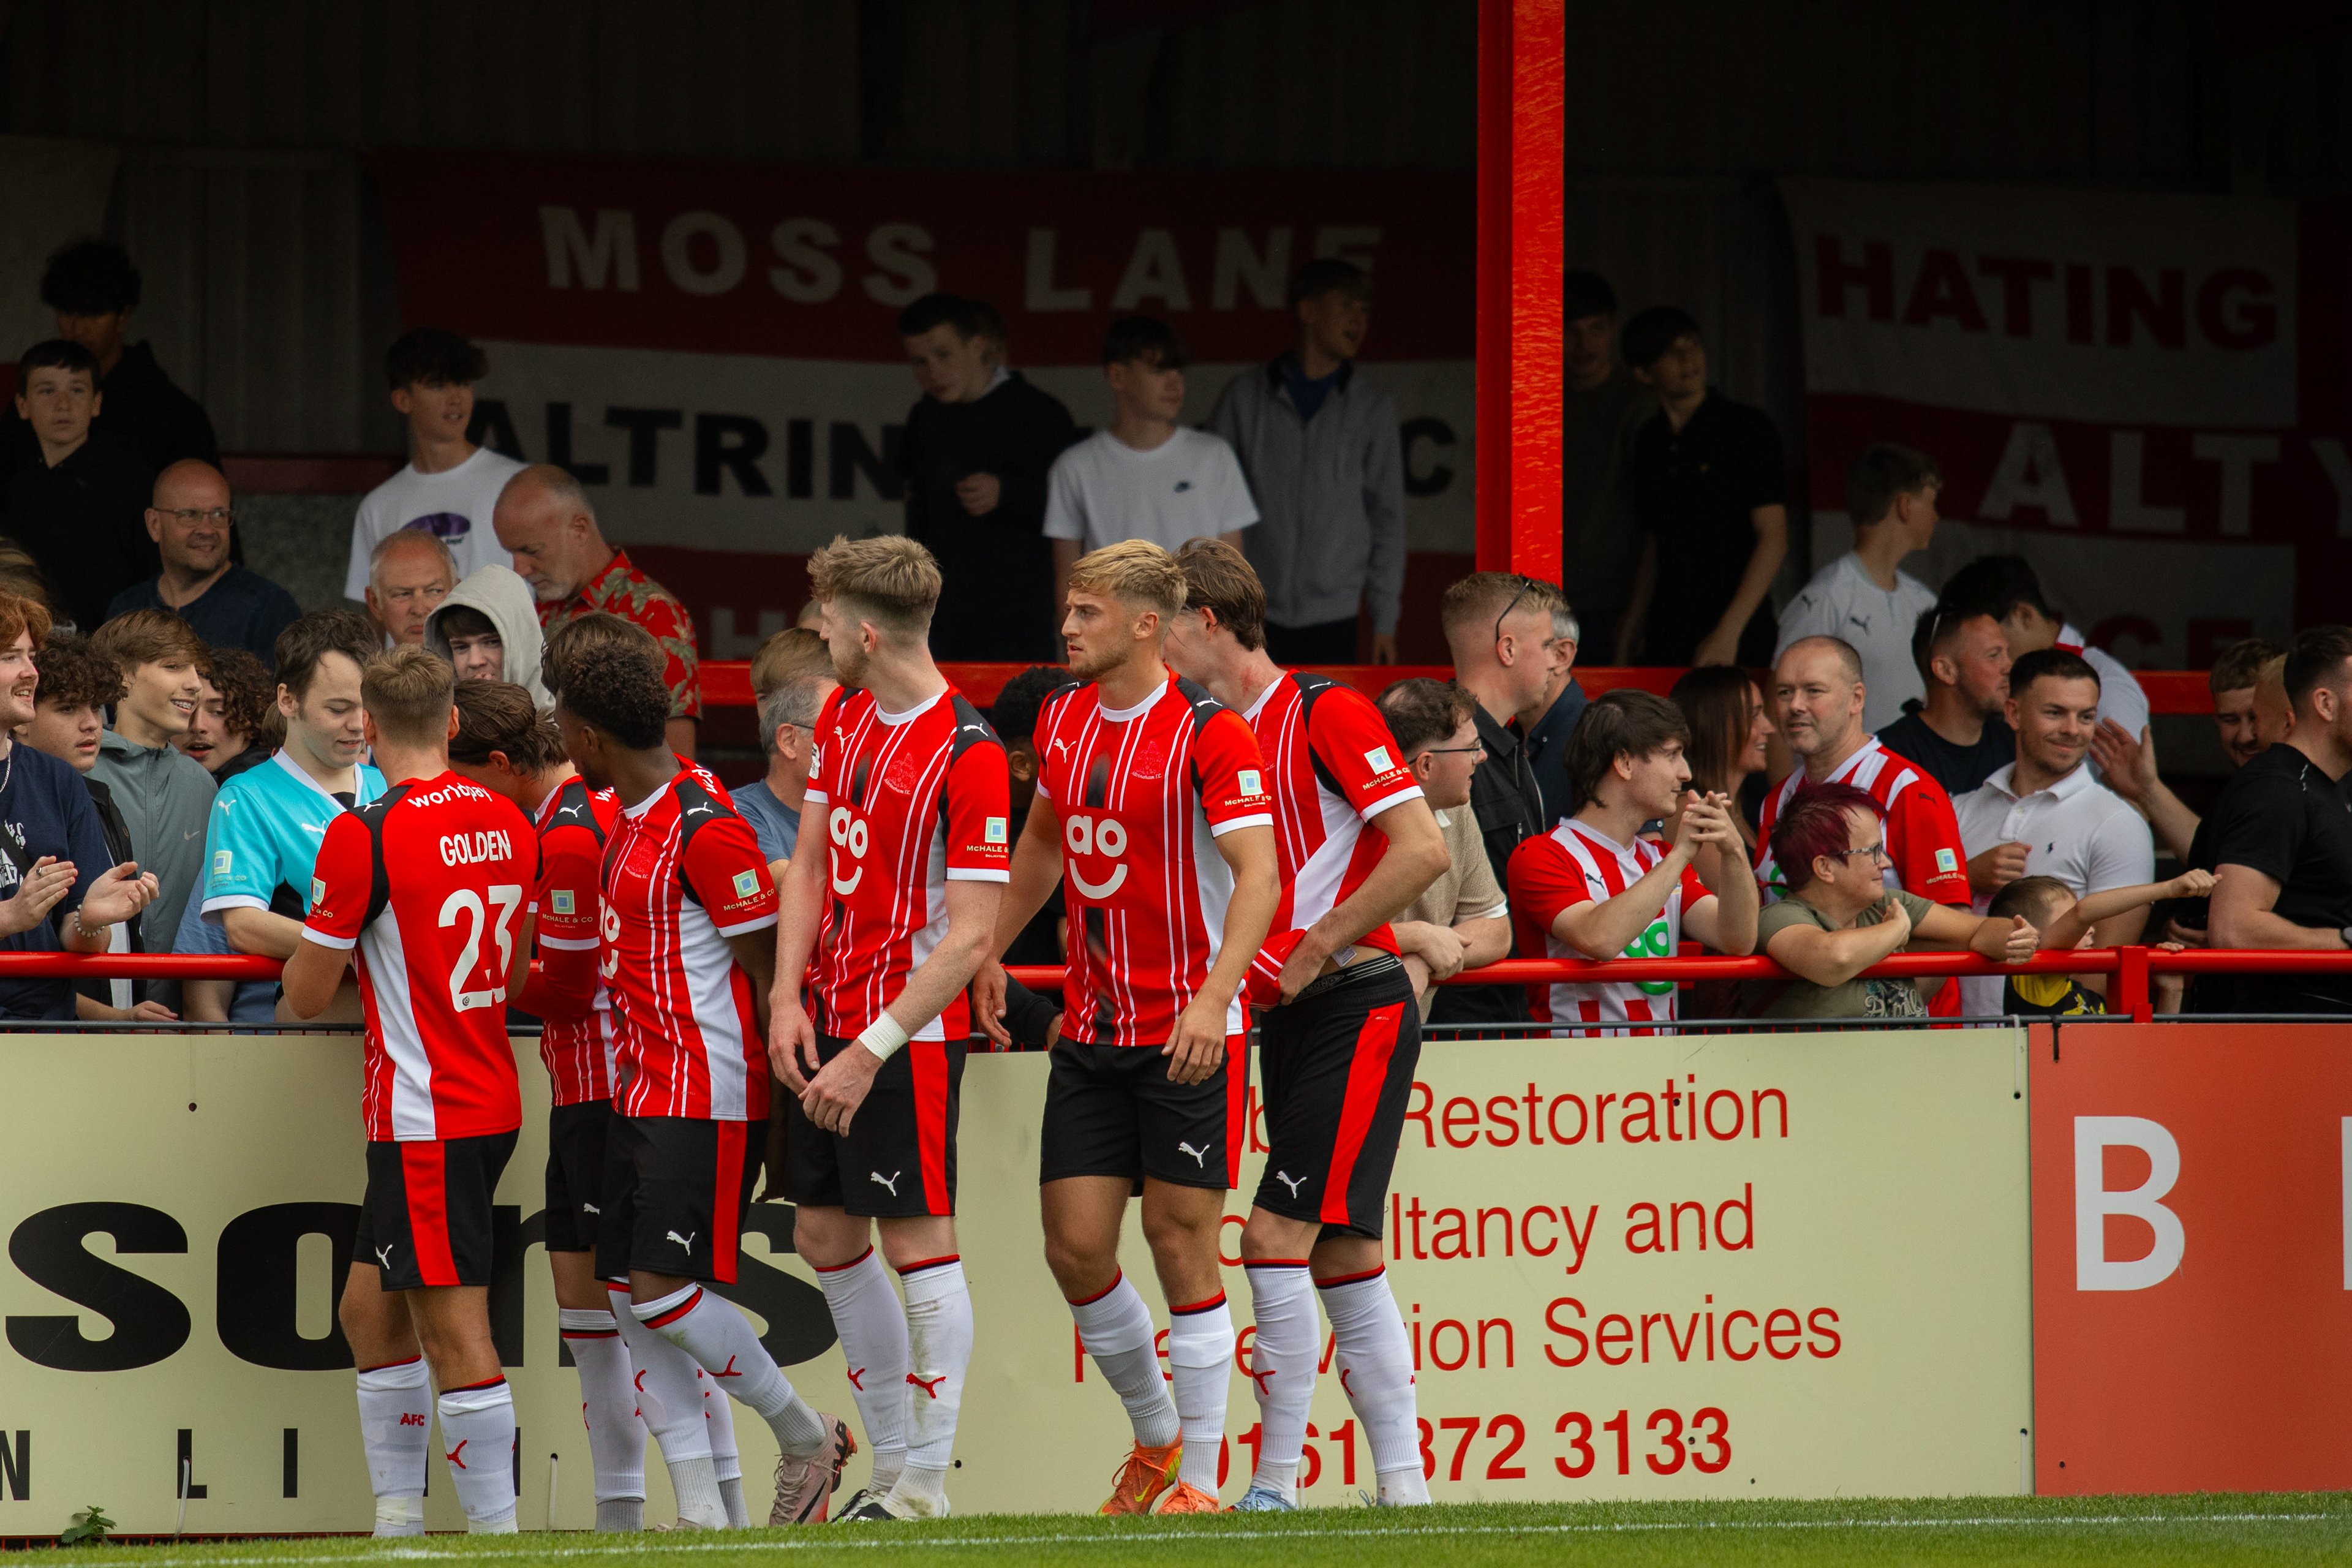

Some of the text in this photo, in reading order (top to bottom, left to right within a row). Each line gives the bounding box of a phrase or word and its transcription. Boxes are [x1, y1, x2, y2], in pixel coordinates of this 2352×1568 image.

[537, 204, 939, 308] MOSS
[1815, 235, 2277, 350] HATING
[464, 398, 913, 502] ALTRIN
[407, 782, 493, 808] worldpay
[439, 829, 512, 867] GOLDEN
[829, 806, 869, 859] ao
[1066, 814, 1128, 858] ao
[438, 884, 522, 1013] 23
[1398, 1073, 1790, 1149] Restoration
[1624, 1182, 1754, 1254] and
[1544, 1294, 1841, 1368] Services
[400, 1412, 425, 1427] AFC
[1553, 1407, 1732, 1479] 3133
